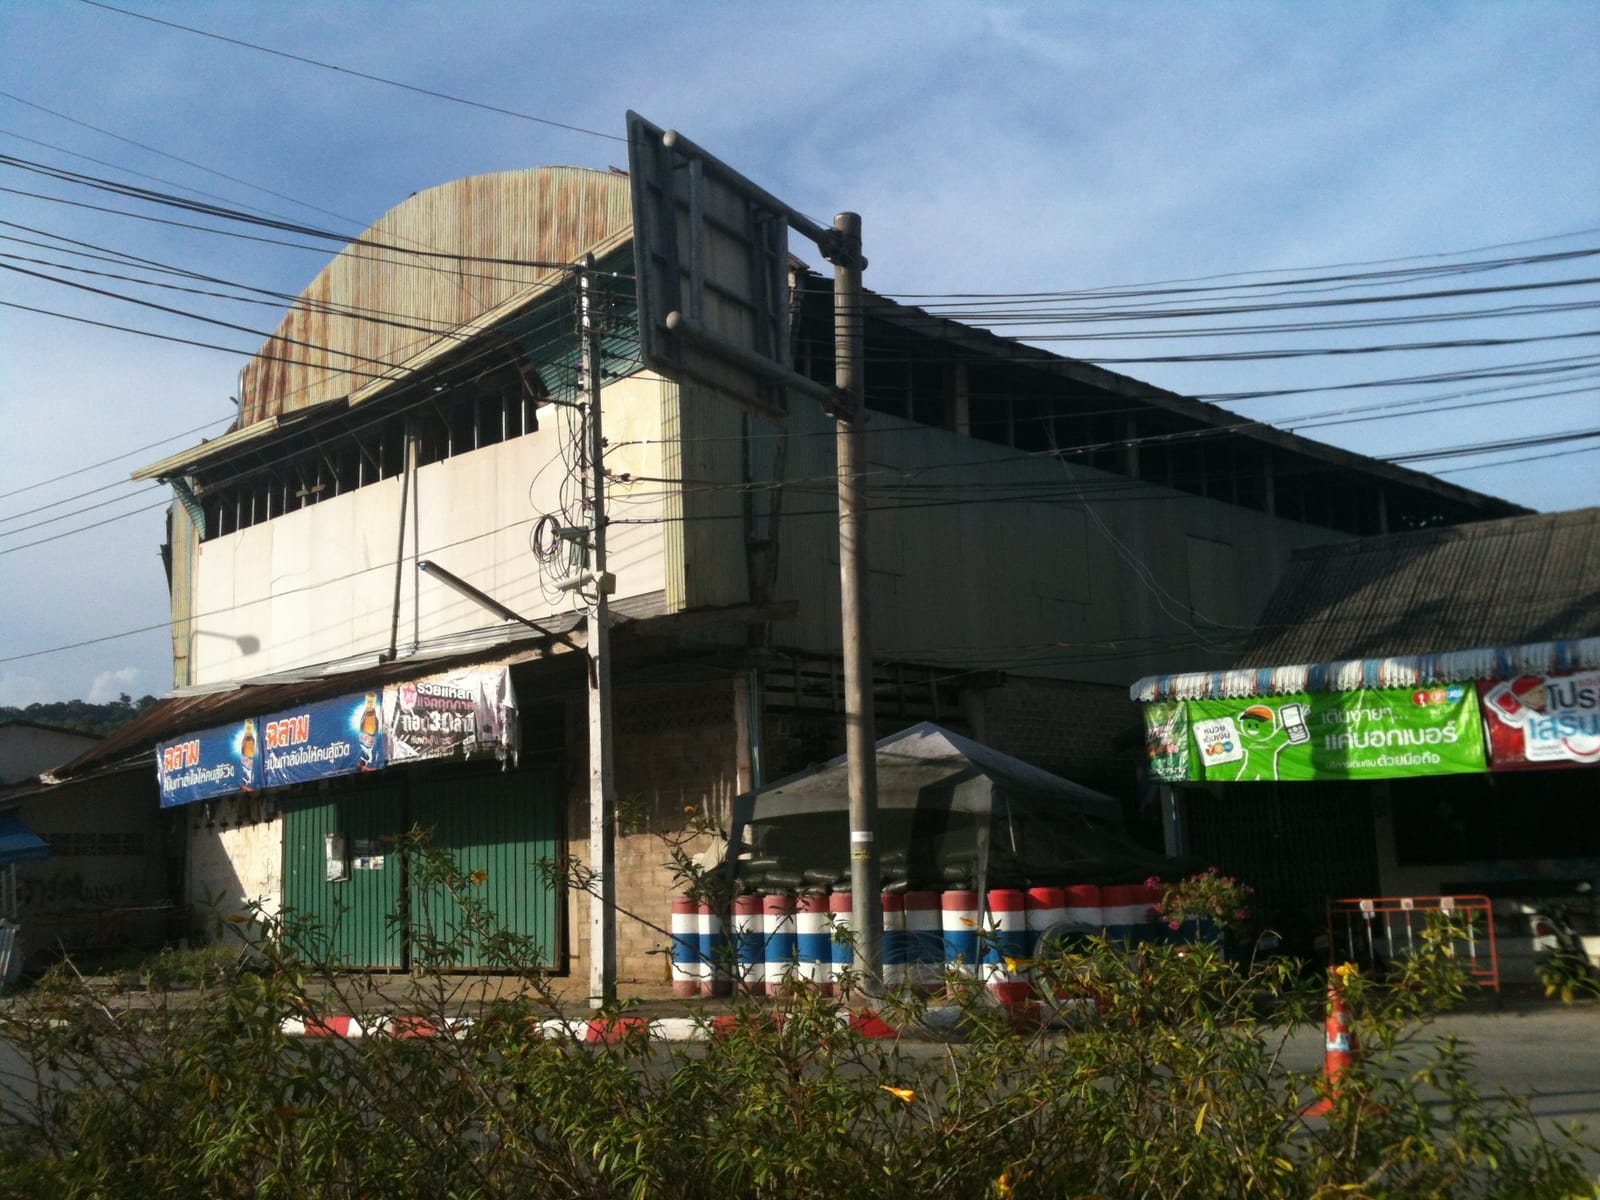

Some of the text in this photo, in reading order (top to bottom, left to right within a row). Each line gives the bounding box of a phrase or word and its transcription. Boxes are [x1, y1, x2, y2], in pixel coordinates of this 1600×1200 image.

[265, 714, 310, 750] ฉลาม
[1325, 719, 1459, 751] แค่บอกเบอร์
[164, 739, 200, 774] ฉลาม
[1377, 751, 1441, 768] ด้วยมือถือ
